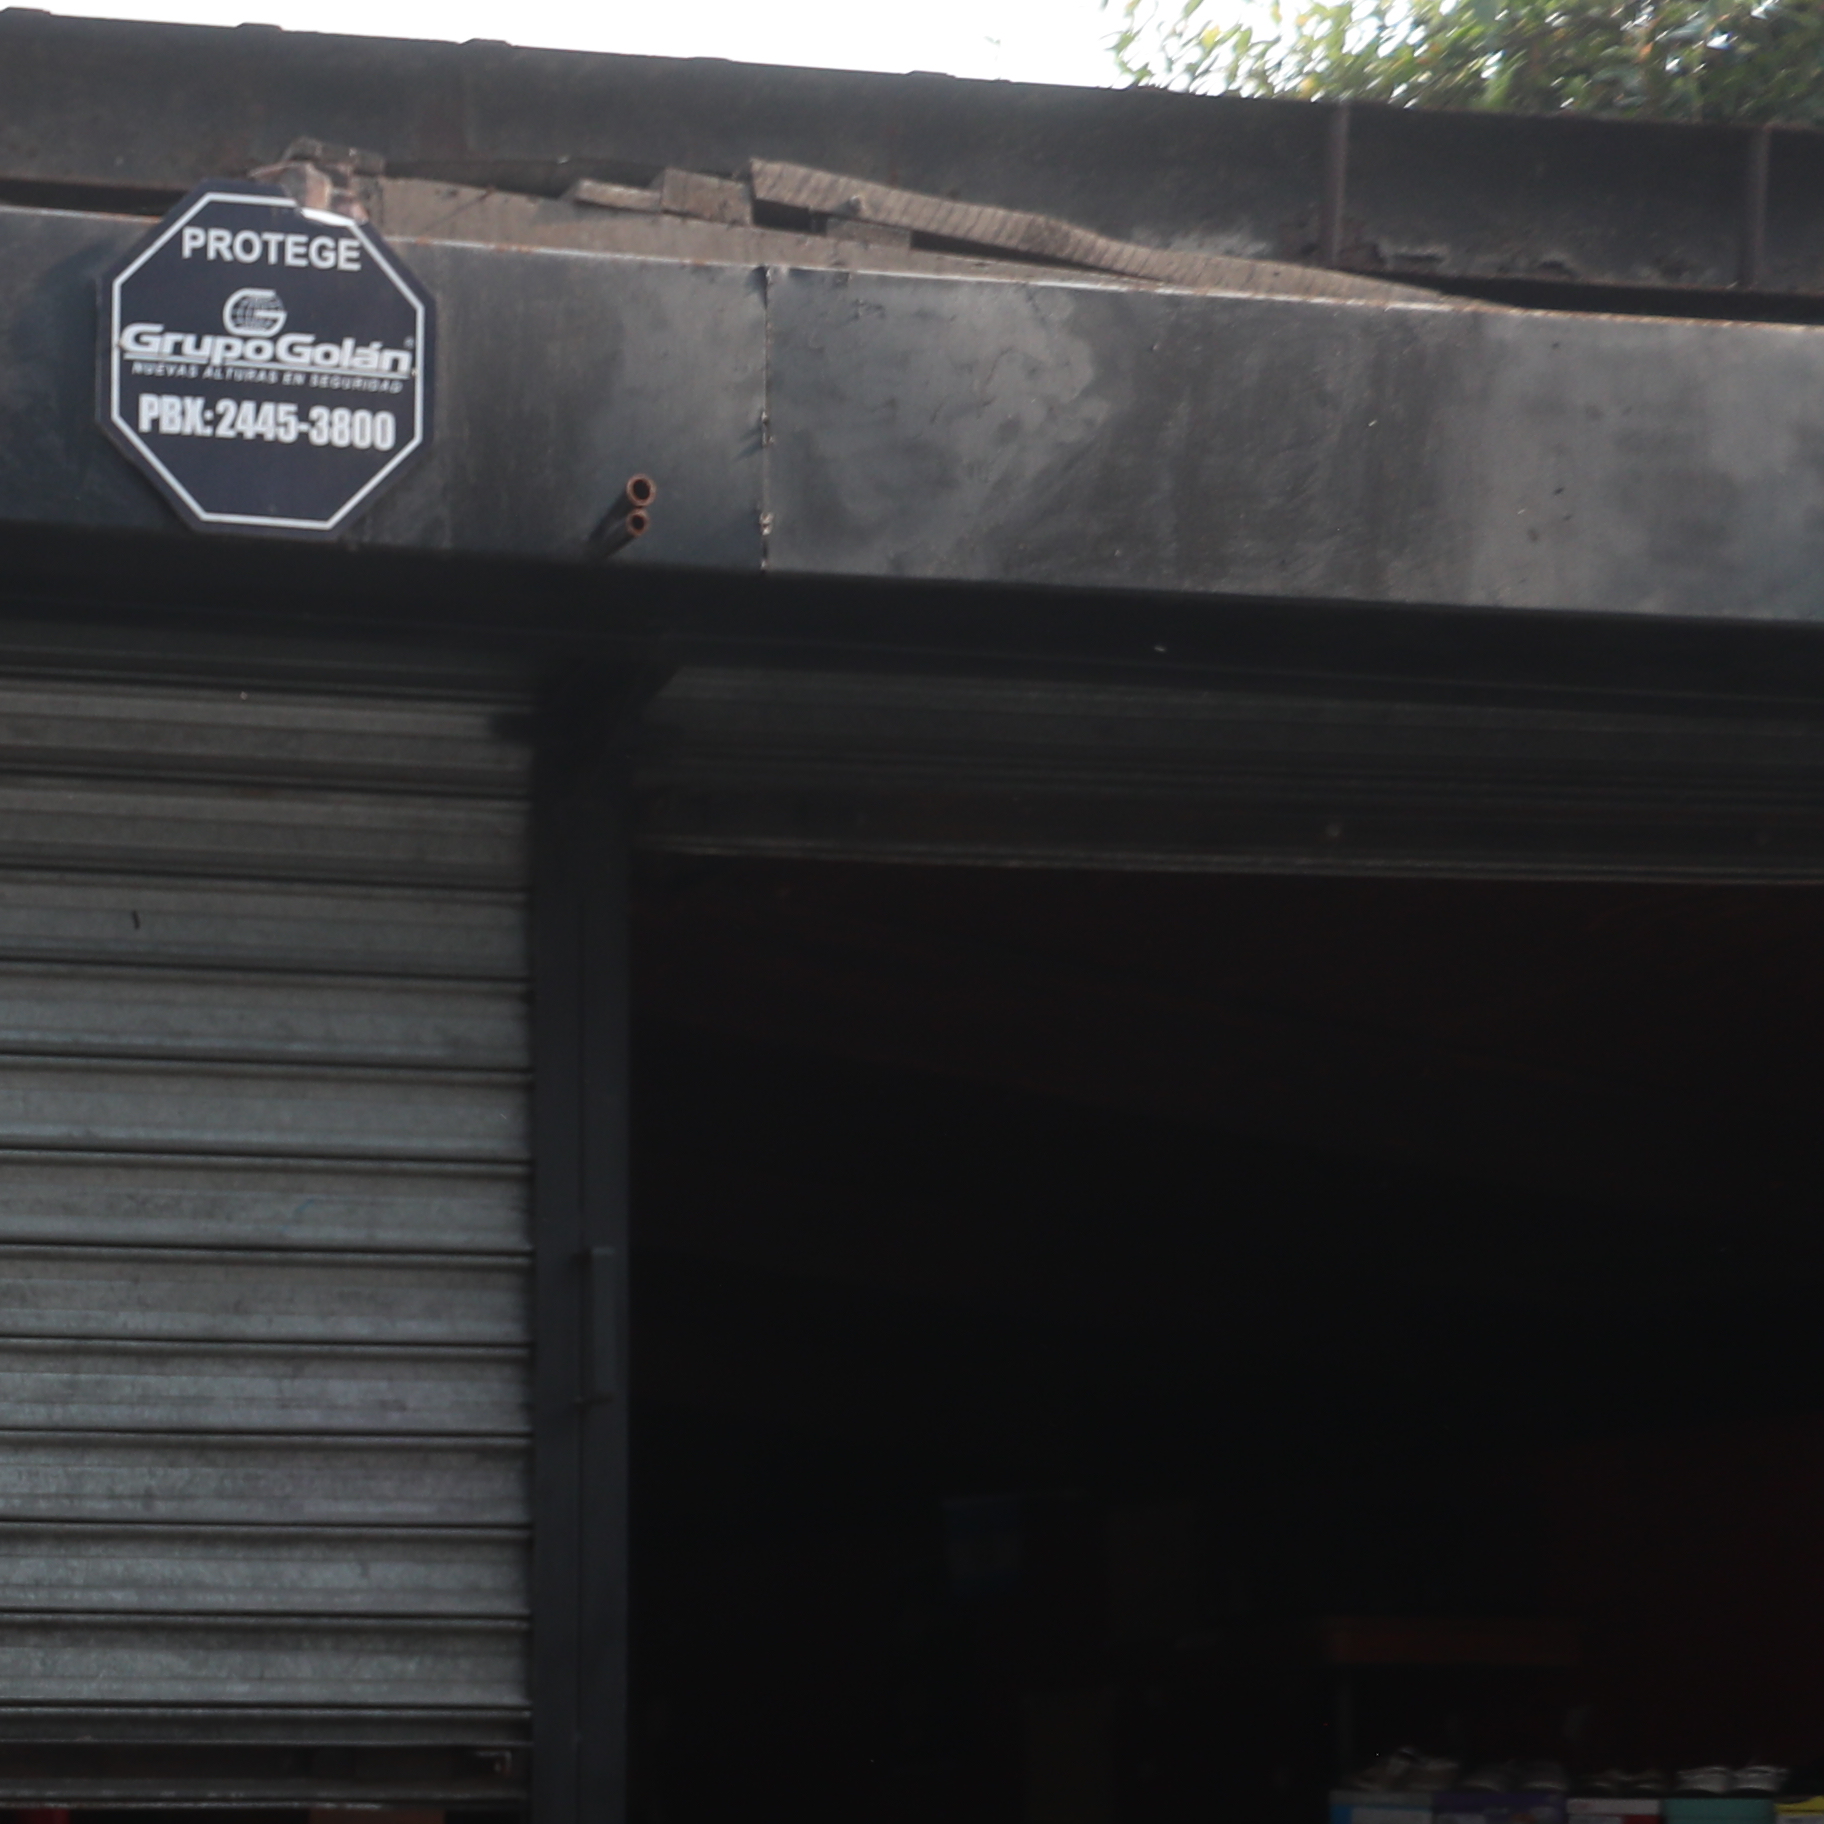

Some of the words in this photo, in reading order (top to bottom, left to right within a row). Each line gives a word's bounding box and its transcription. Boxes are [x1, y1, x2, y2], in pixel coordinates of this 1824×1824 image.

[181, 226, 362, 271] PROTEGE
[131, 361, 197, 379] NUEVAS
[202, 364, 278, 385] ALTURAS
[282, 372, 306, 386] EN
[309, 374, 404, 395] SEGURIDAD
